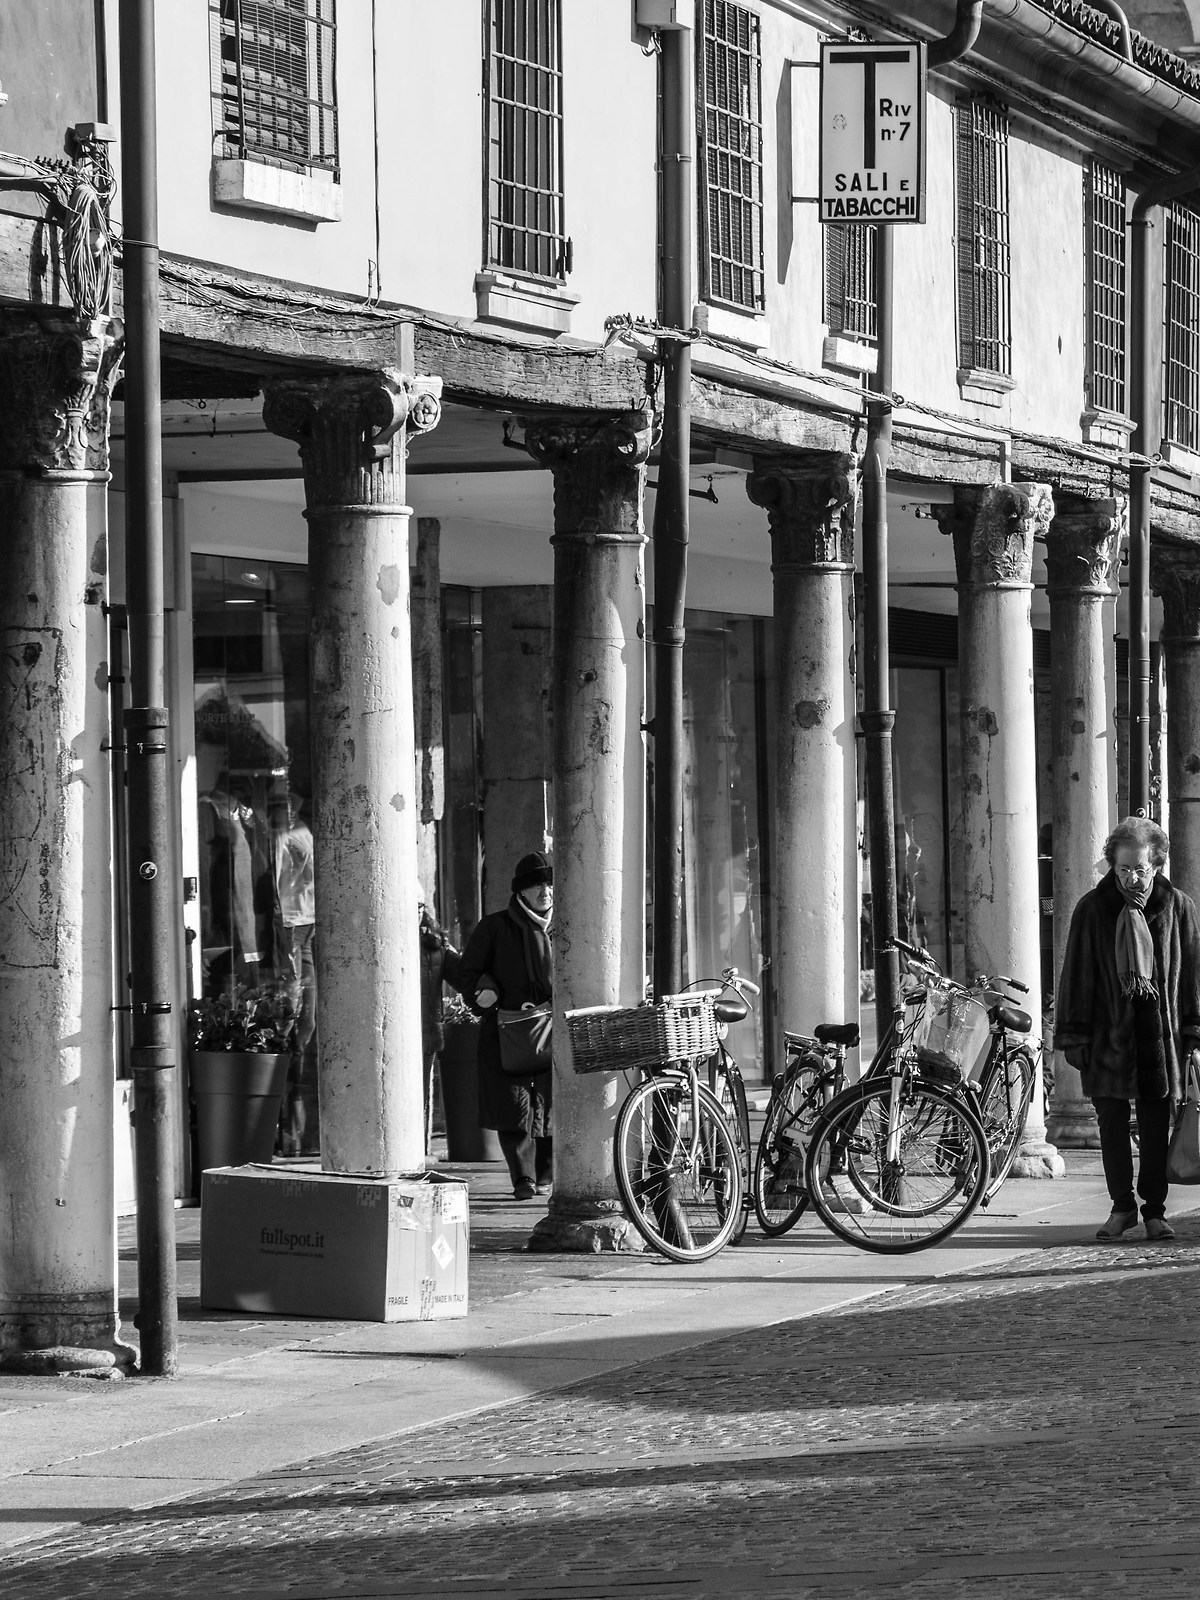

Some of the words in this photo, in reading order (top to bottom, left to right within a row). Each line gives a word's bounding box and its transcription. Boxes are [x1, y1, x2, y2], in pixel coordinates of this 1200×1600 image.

[829, 50, 910, 169] T
[834, 172, 888, 192] SALI
[899, 179, 910, 191] E
[823, 196, 915, 217] TABACCHI
[260, 1227, 325, 1250] fullspot.it
[387, 1296, 409, 1306] FRAGILE
[434, 1295, 448, 1304] MADE
